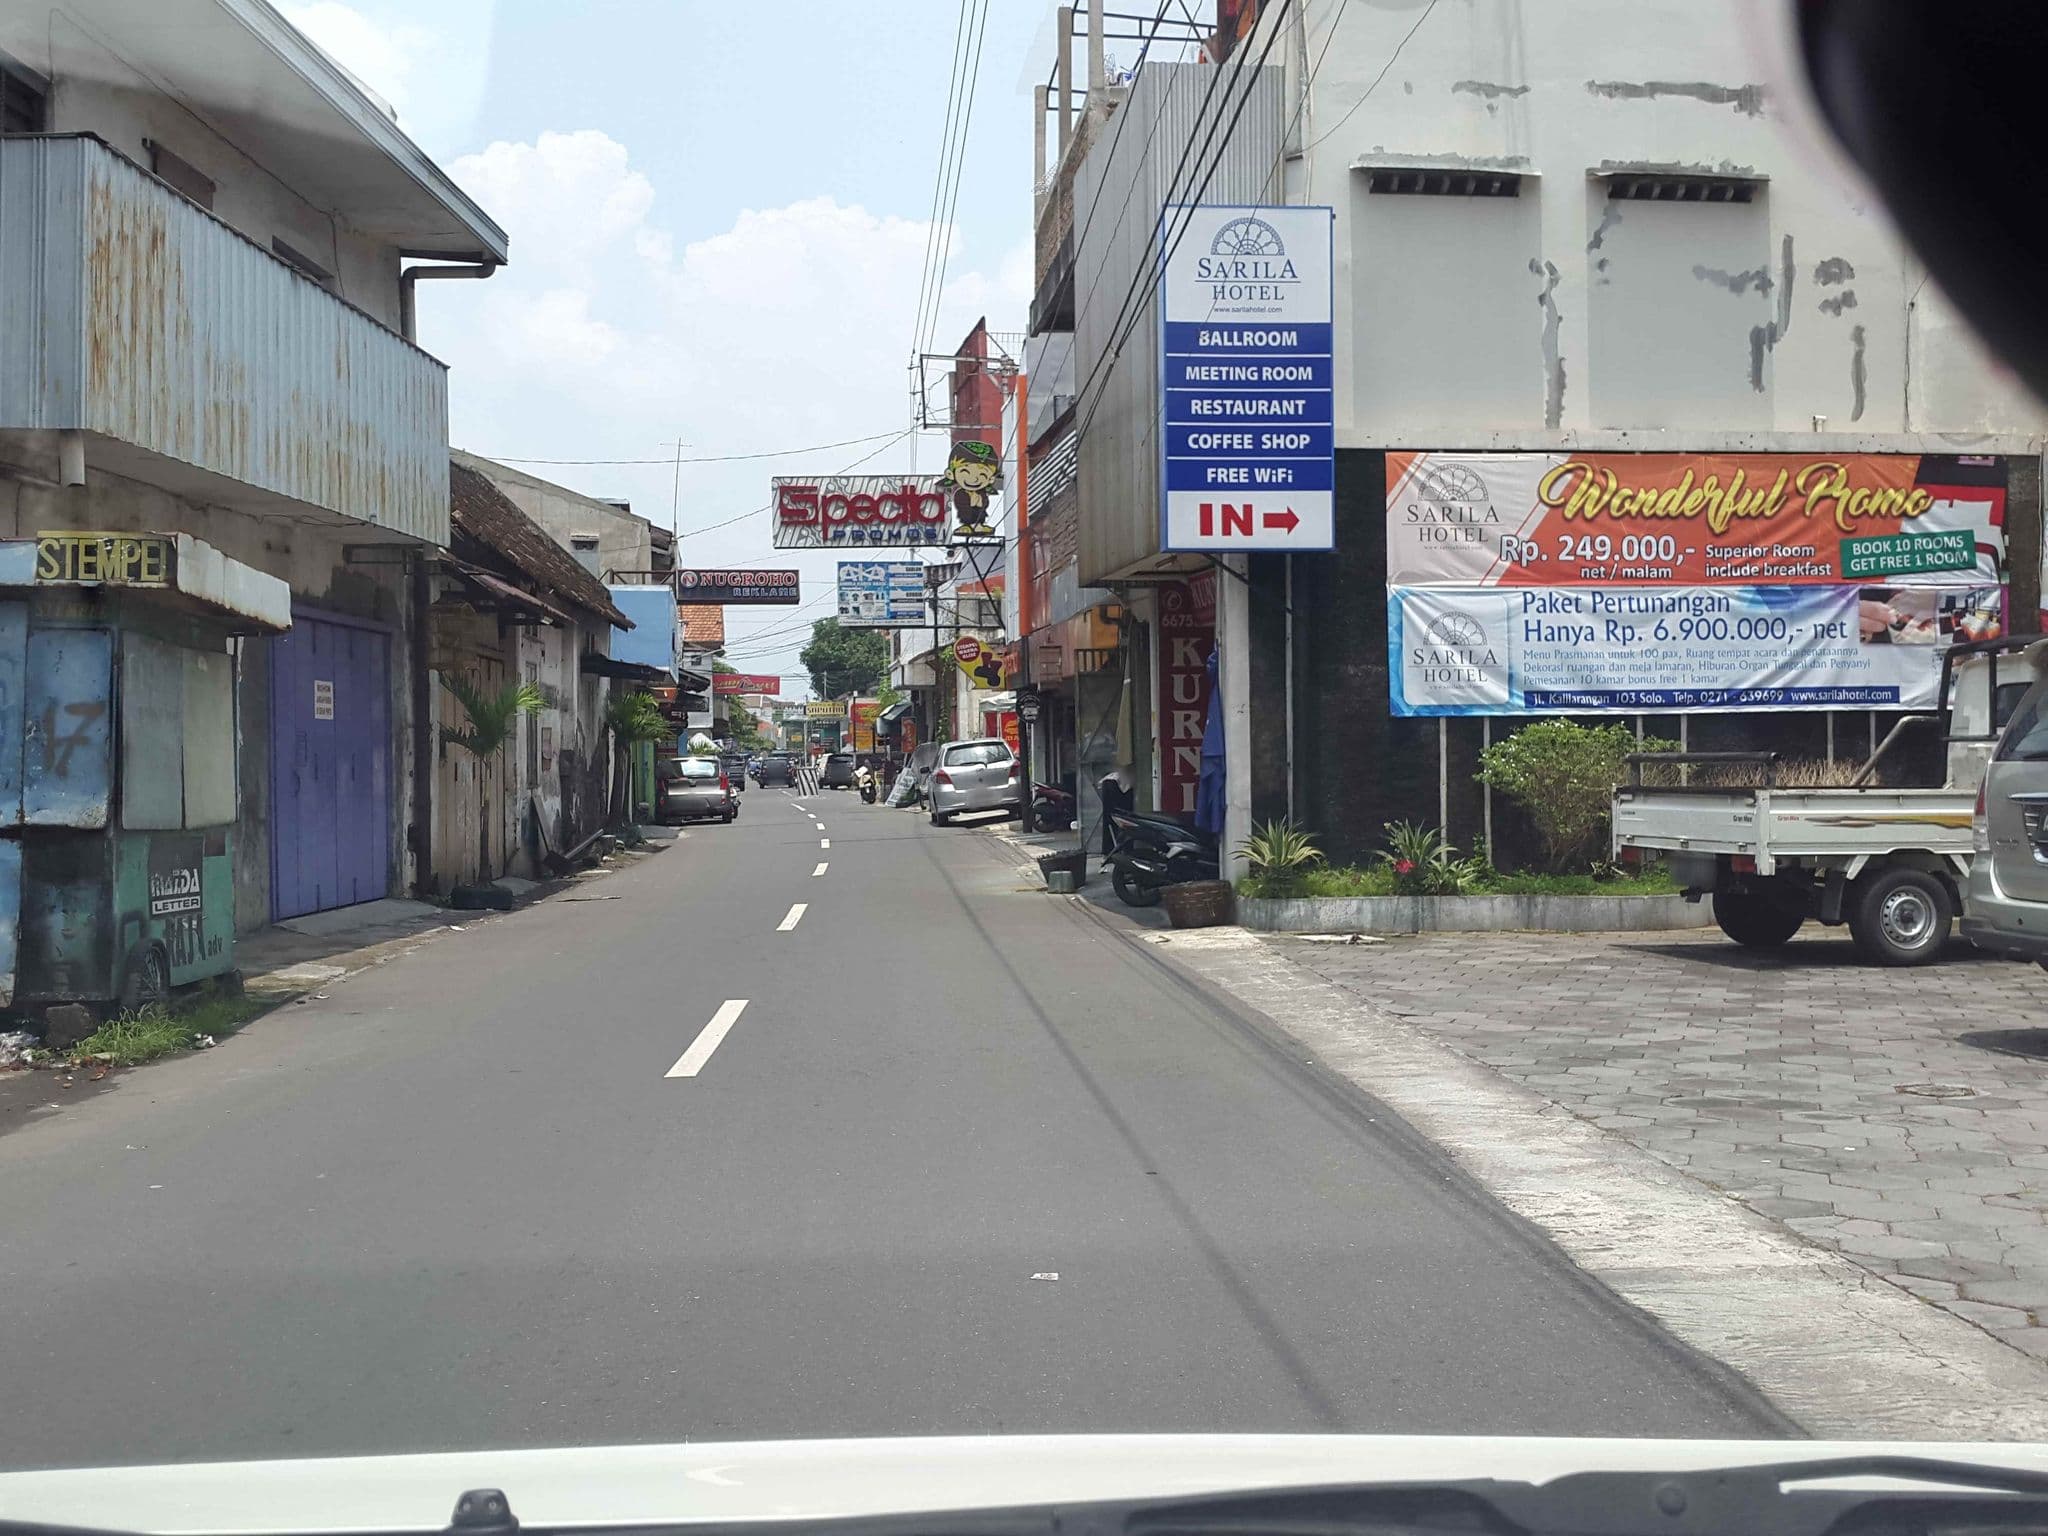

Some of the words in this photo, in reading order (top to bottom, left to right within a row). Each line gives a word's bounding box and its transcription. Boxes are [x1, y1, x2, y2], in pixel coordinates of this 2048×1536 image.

[1198, 258, 1298, 279] SARILA
[1212, 285, 1285, 301] HOTEL
[1214, 305, 1283, 314] www.sarilahotel.com
[1199, 330, 1297, 346] BALLROOM
[1185, 366, 1258, 381] MEETING
[1262, 366, 1313, 381] ROOM
[1190, 399, 1306, 415] RESTAURANT
[1187, 433, 1254, 449] COFFEE
[1261, 433, 1311, 449] SHOP
[1206, 467, 1249, 483] FREE
[1254, 467, 1293, 483] WiFi
[1539, 462, 1787, 534] Wonderful
[1796, 462, 1934, 531] Promo
[1199, 503, 1253, 536] IN
[1407, 504, 1500, 523] SARILA
[833, 528, 947, 540] PROMOSI
[1420, 527, 1489, 542] HOTEL
[1500, 534, 1548, 568] Rp.
[1557, 534, 1696, 566] 249.000,-
[1705, 544, 1769, 560] Superior
[1772, 543, 1815, 558] Room
[1852, 541, 1891, 556] BOOK
[1895, 539, 1911, 552] 10
[1914, 535, 1964, 551] ROOMS
[1850, 558, 1877, 572] GET
[1880, 554, 1911, 569] FREE
[1915, 553, 1922, 567] 1
[1926, 550, 1969, 565] ROOM
[1581, 566, 1606, 579] net
[1622, 565, 1673, 579] malam
[1705, 563, 1760, 577] include
[1763, 562, 1832, 576] breakfast
[700, 571, 797, 587] NUGROHO
[733, 587, 797, 597] REKLAME
[1523, 591, 1582, 614] Paket
[1592, 591, 1730, 617] Pertunangan
[1524, 619, 1595, 646] Hanya
[1605, 619, 1643, 646] Rp.
[1654, 617, 1803, 644] 6.900.000,-
[1813, 620, 1848, 640] net
[1413, 648, 1498, 665] SARILA
[1523, 649, 1551, 660] Menu
[1554, 649, 1605, 660] Prasmanan
[1608, 649, 1635, 660] untuk
[1640, 648, 1659, 659] 100
[1686, 648, 1714, 660] Ruang
[1717, 648, 1750, 660] tempat
[1754, 649, 1778, 658] acara
[1523, 661, 1563, 673] Dekorasi
[1566, 662, 1605, 674] ruangan
[1608, 661, 1626, 672] dan
[1628, 662, 1652, 673] meja
[1654, 660, 1695, 673] lamaran,
[1699, 660, 1736, 671] Hiburan
[1739, 660, 1769, 672] Organ
[1810, 658, 1827, 669] dan
[1830, 658, 1871, 670] Penyanyi
[1424, 668, 1488, 683] HOTEL
[1523, 674, 1575, 685] Pemesanan
[1580, 674, 1593, 685] 10
[1595, 674, 1625, 685] kamar
[1628, 673, 1656, 684] bonus
[1660, 673, 1678, 684] free
[1690, 673, 1719, 684] kamar
[1615, 692, 1636, 704] 103
[1640, 691, 1666, 704] Solo.
[1673, 691, 1697, 704] Telp.
[1700, 691, 1728, 703] 0271
[1739, 690, 1784, 702] 639699
[1791, 689, 1892, 702] www.sarilahotel.com
[154, 898, 200, 912] LETTER
